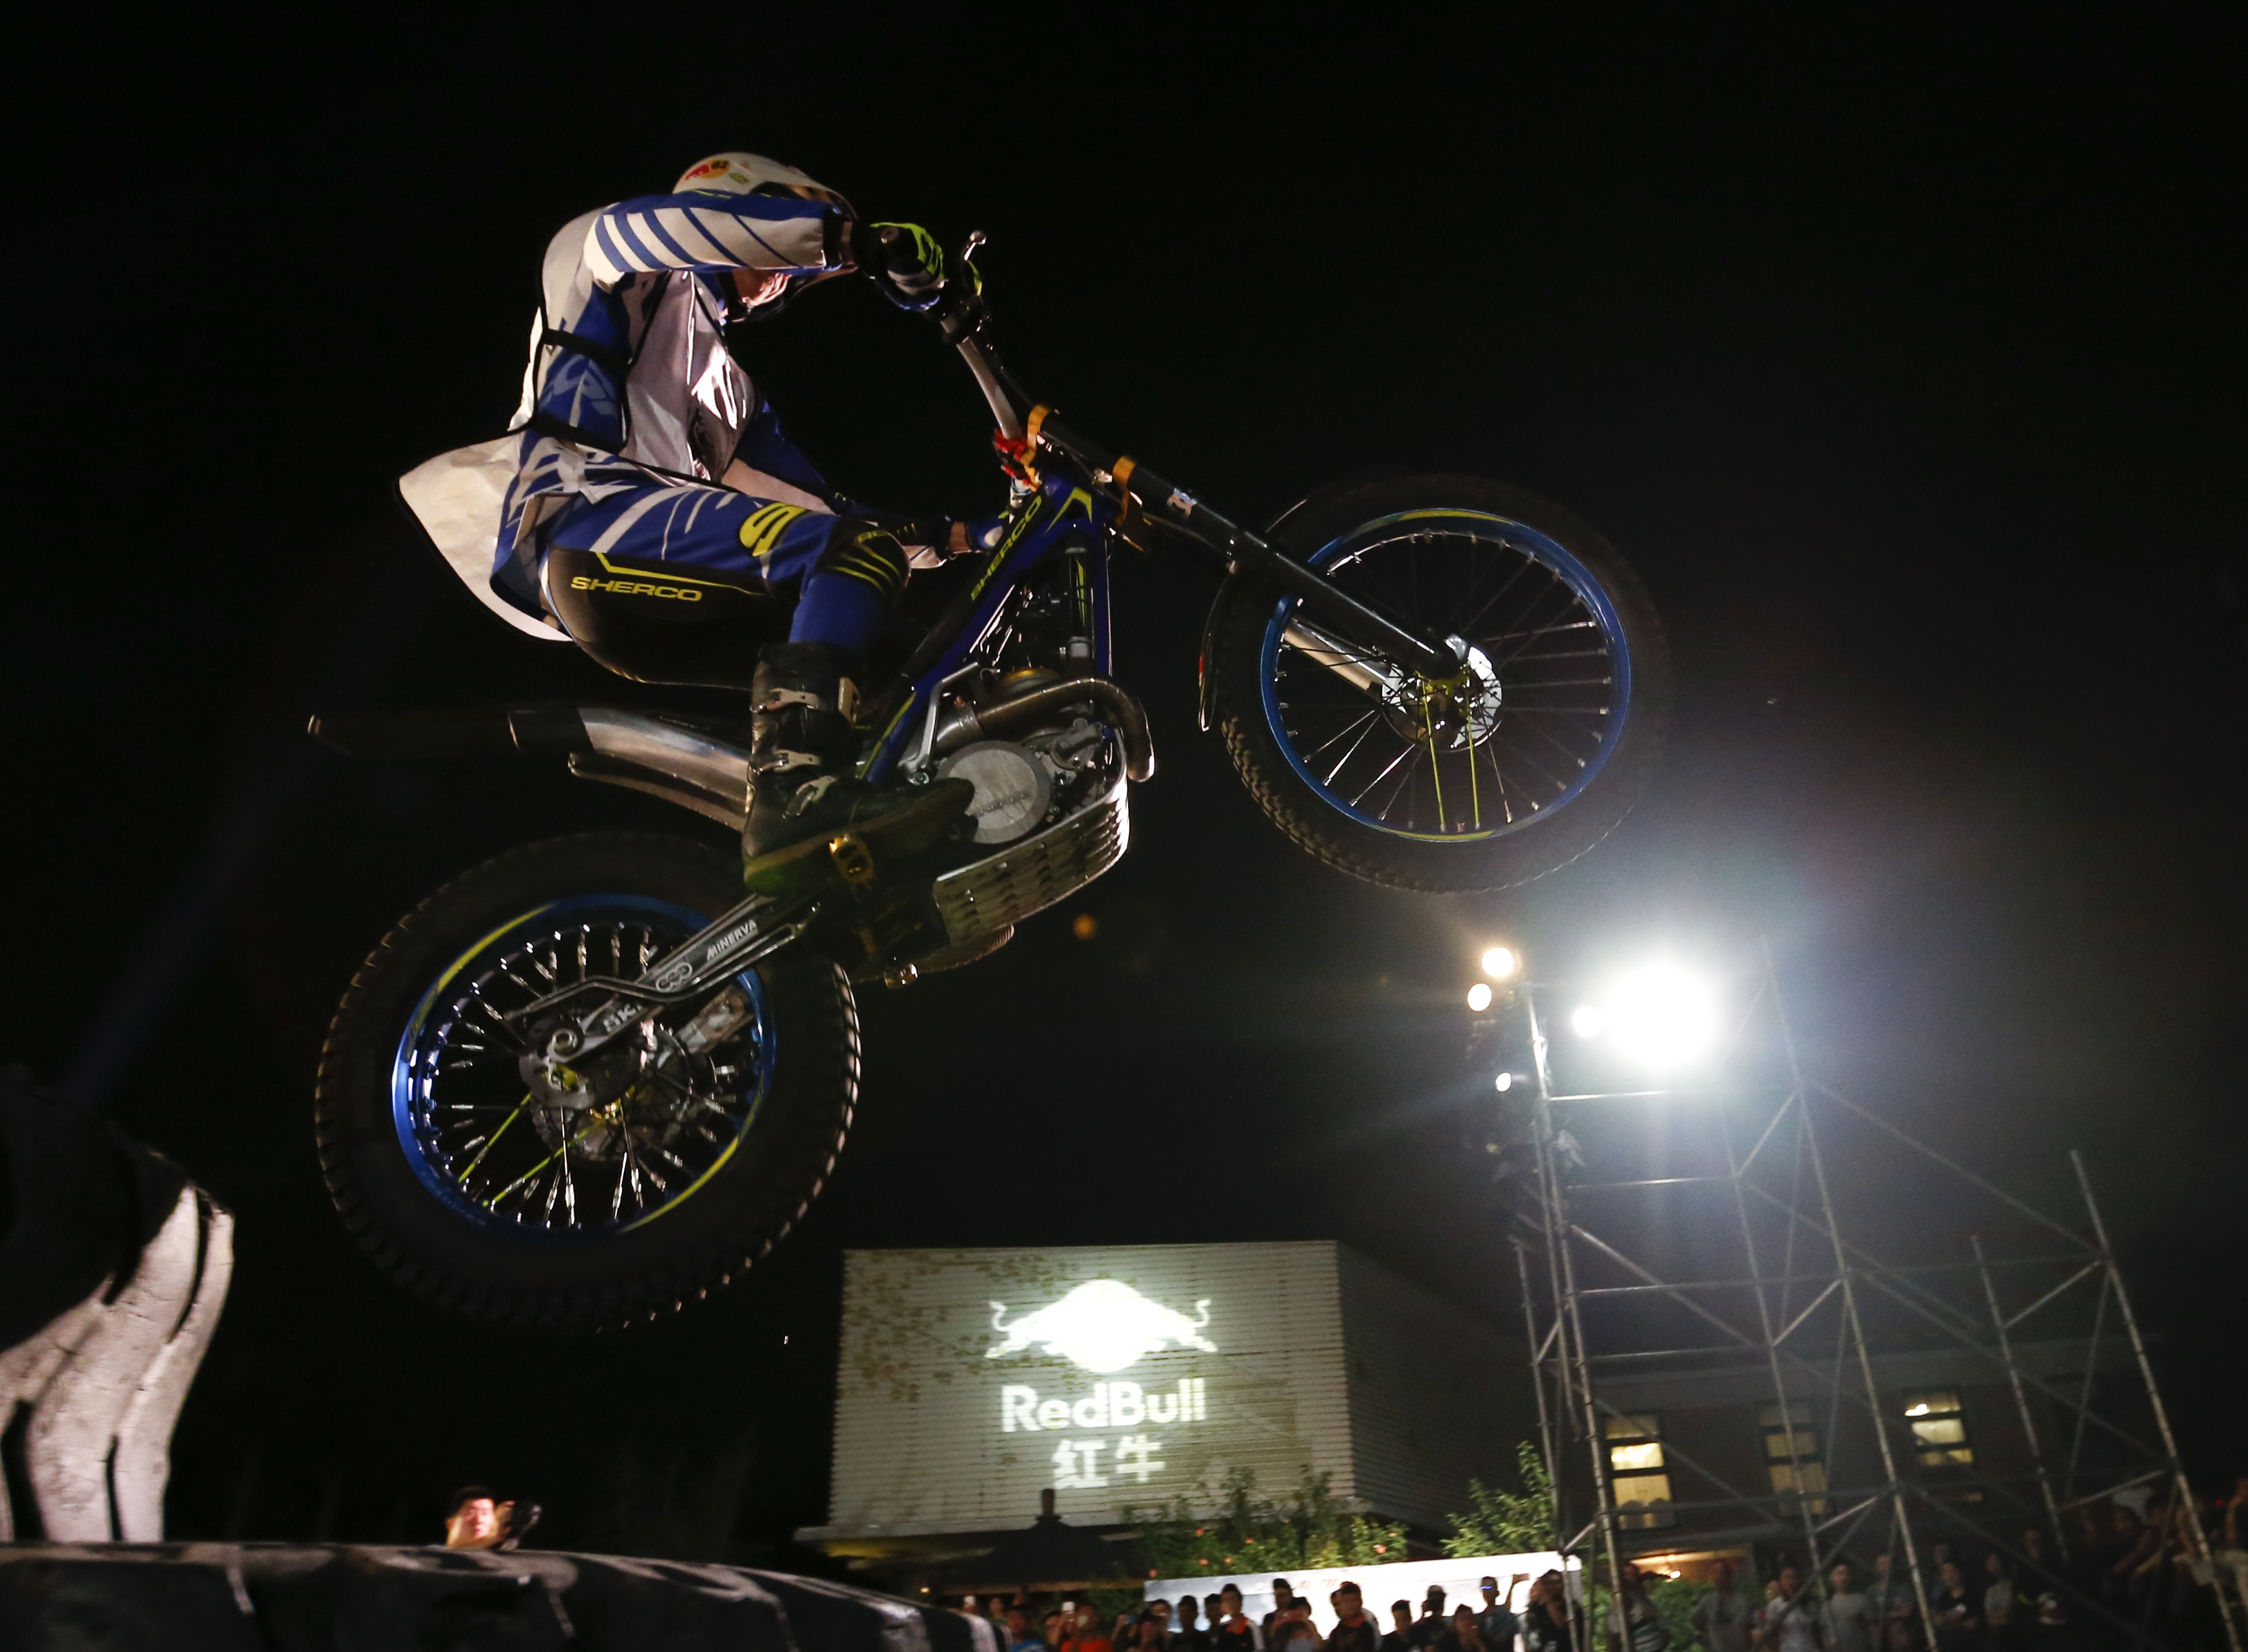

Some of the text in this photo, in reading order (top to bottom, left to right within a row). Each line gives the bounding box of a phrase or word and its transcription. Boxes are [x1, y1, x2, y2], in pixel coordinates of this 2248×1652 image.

[971, 495, 1043, 601] SHERCO
[571, 576, 703, 602] SHERCO
[706, 918, 758, 962] MINERVA
[1001, 1378, 1206, 1432] RedBull
[1052, 1434, 1166, 1490] 红牛
